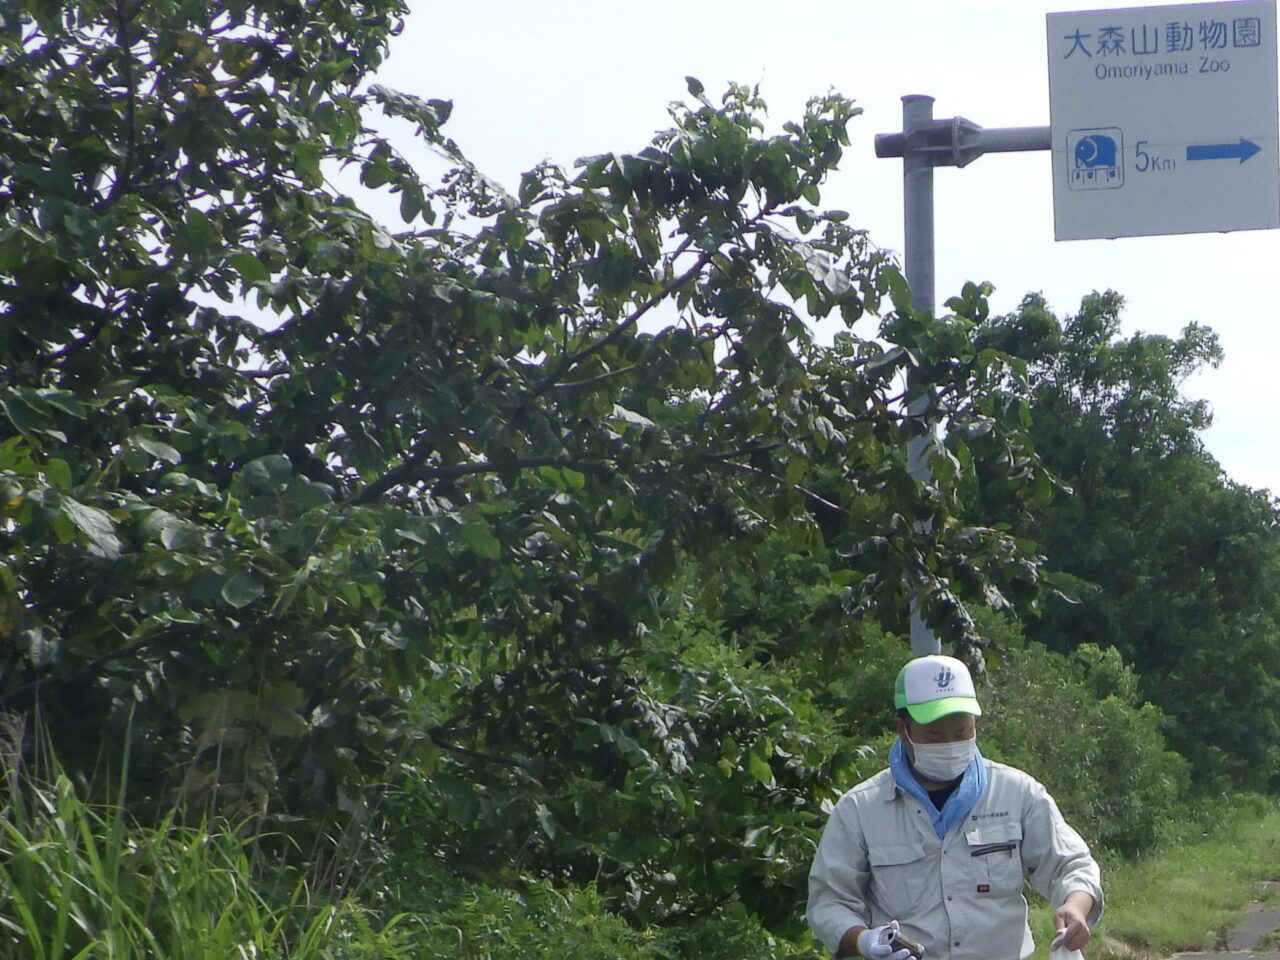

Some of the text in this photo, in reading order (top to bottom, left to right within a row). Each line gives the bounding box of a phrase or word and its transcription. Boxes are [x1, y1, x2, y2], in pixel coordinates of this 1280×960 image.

[1064, 17, 1261, 59] 大森山動物園
[1095, 56, 1230, 80] Omoriyama Zoo
